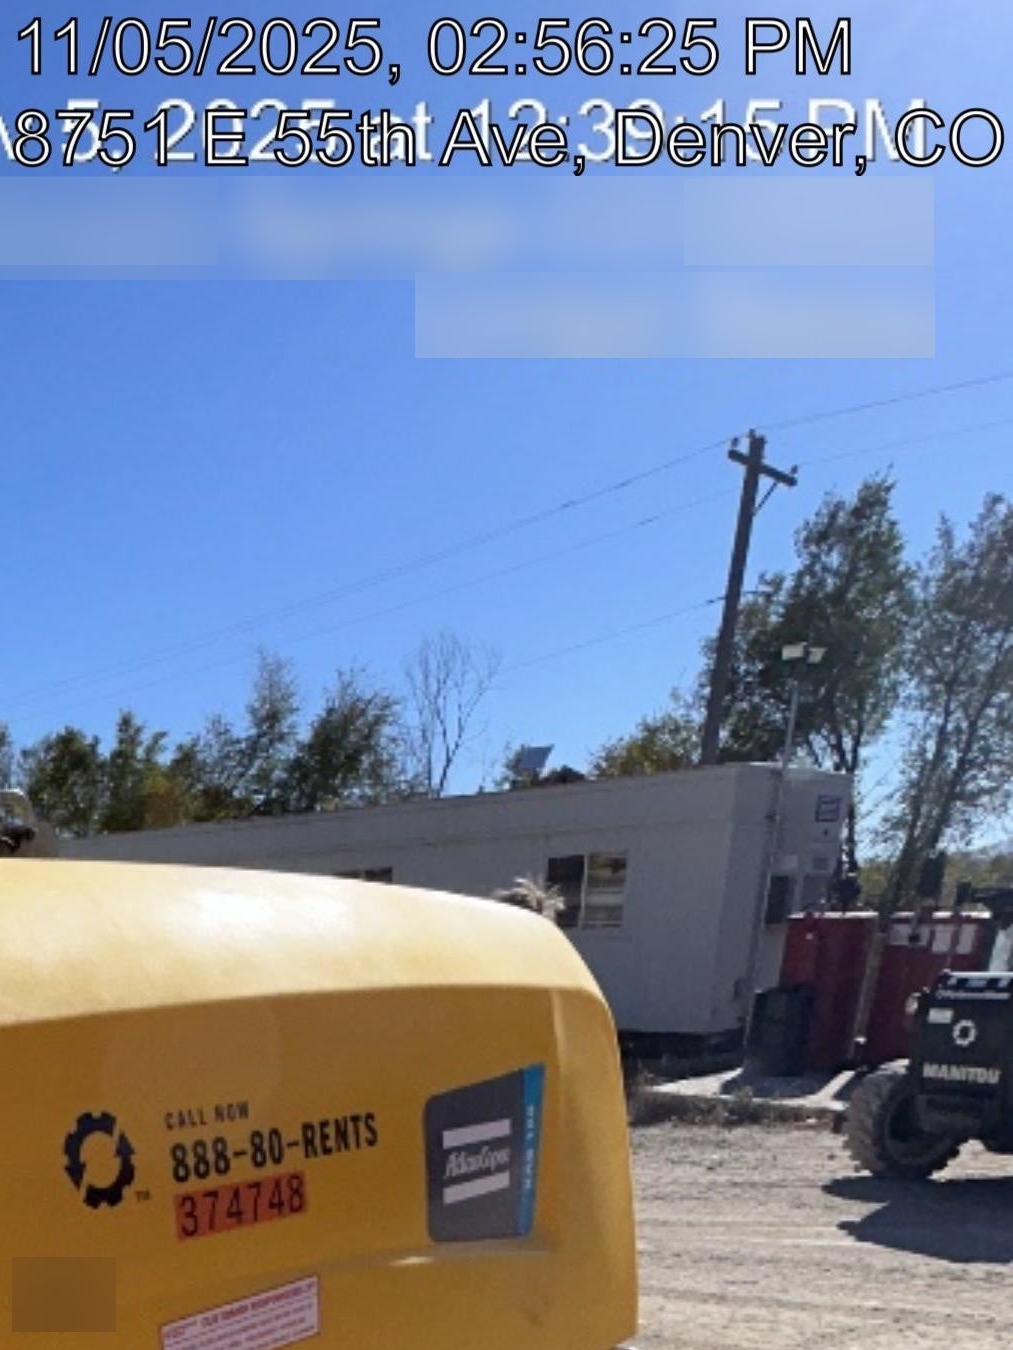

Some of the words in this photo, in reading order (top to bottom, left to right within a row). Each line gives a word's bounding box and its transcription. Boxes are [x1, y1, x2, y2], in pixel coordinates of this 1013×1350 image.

[922, 1061, 1002, 1085] MANITOU
[164, 1106, 208, 1131] CALL
[214, 1101, 250, 1124] NOW
[169, 1111, 379, 1183] 888-80-RENTS
[178, 1173, 305, 1238] 374748
